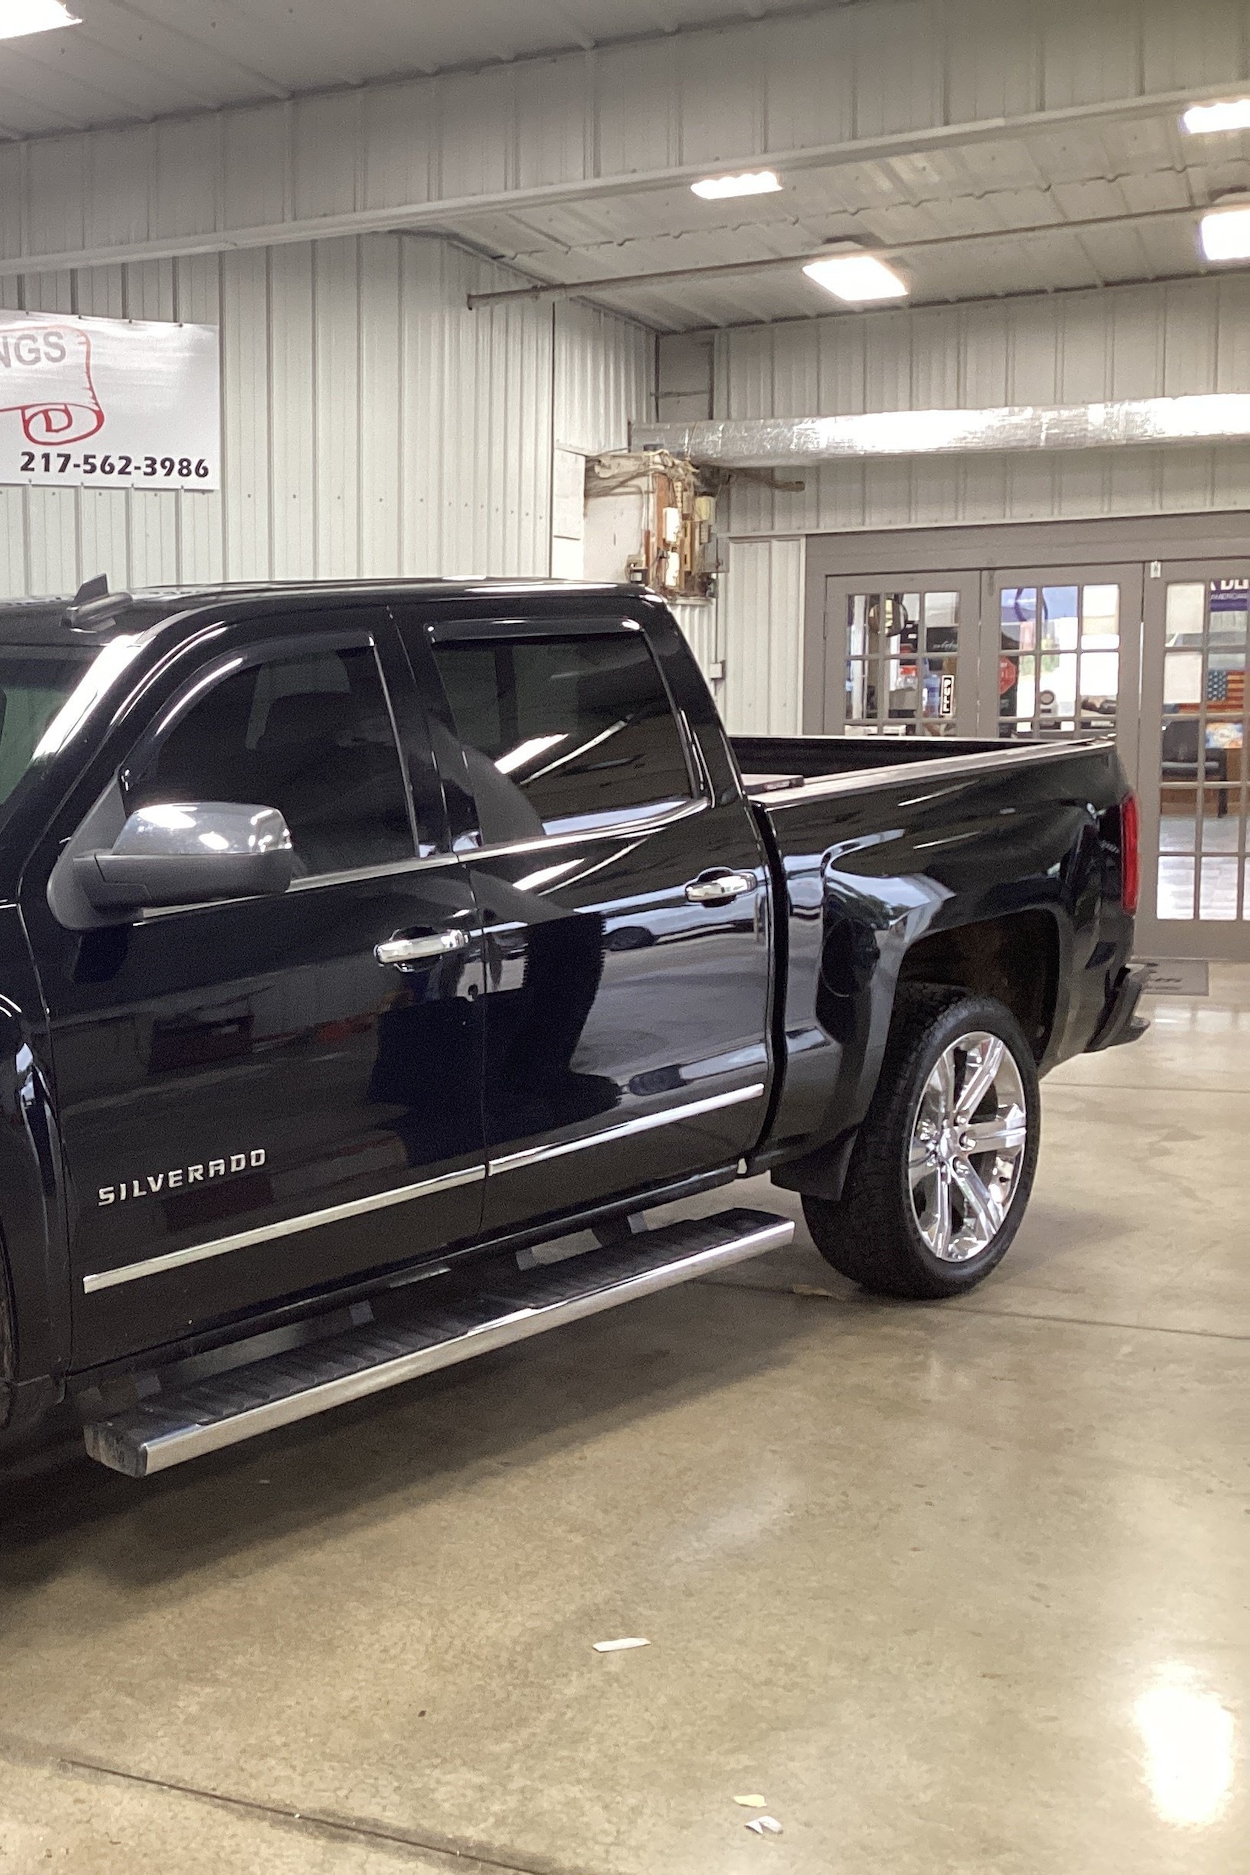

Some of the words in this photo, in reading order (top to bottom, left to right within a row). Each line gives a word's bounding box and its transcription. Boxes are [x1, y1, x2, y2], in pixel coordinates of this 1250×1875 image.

[20, 451, 210, 479] 217-562-3986
[941, 677, 953, 714] PULL
[98, 1149, 265, 1206] SILVERADO
